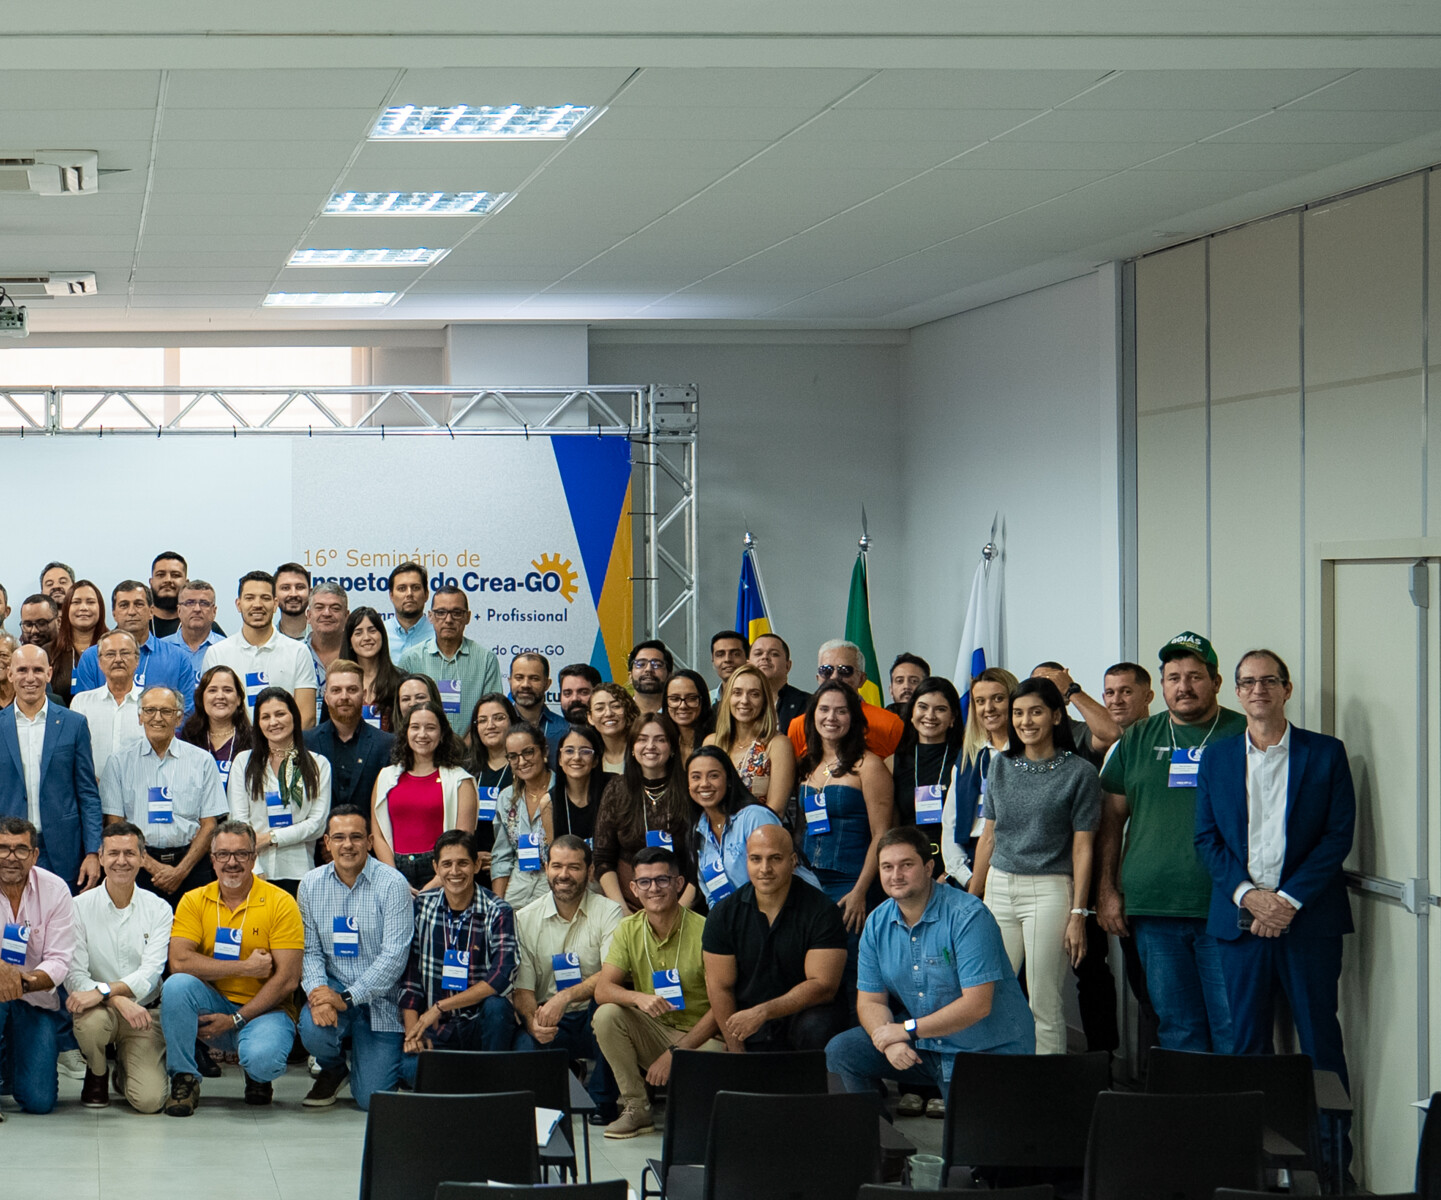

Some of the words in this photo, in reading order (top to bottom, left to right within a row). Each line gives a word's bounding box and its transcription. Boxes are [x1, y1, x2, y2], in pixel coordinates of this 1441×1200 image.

[346, 548, 449, 567] Seminário
[456, 549, 480, 567] de
[430, 572, 459, 592] do
[462, 571, 561, 592] Crea-GO
[487, 608, 568, 622] Profissional
[491, 644, 507, 656] do
[510, 644, 565, 656] Crea-GO
